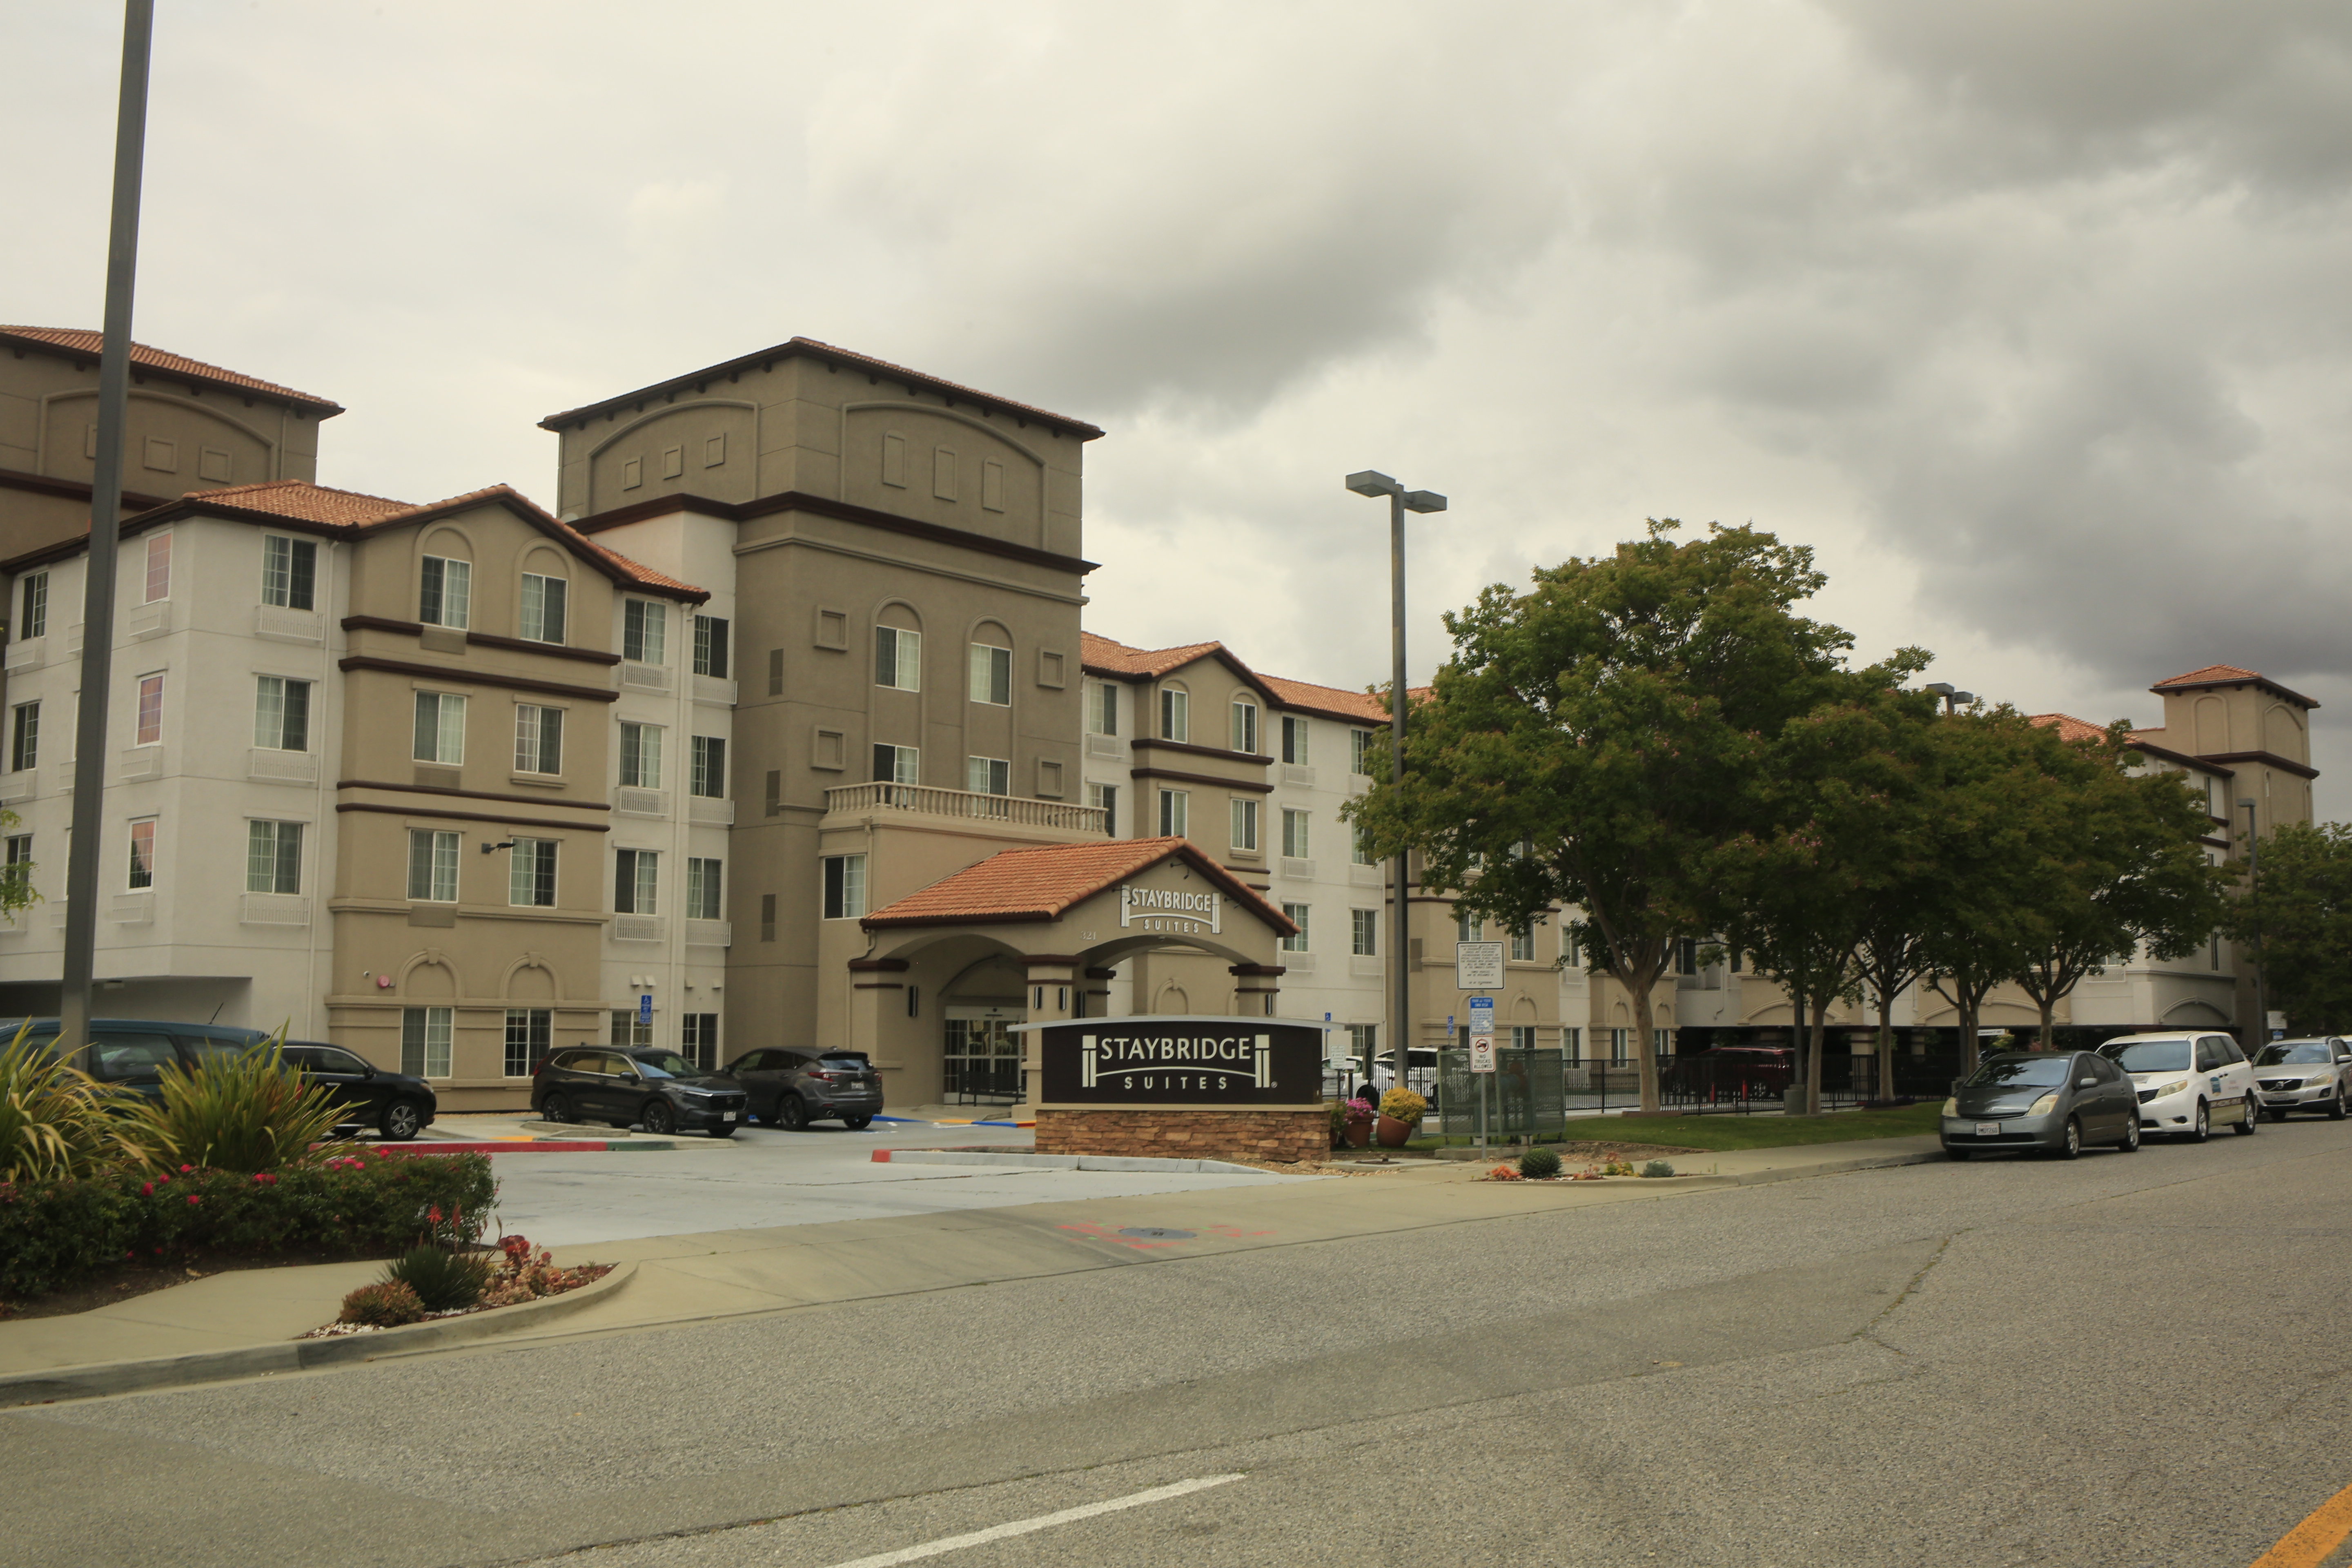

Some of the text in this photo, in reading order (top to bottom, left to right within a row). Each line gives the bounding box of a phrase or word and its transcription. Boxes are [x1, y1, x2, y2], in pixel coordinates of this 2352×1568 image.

[1131, 887, 1211, 912] STAYBRIDGE
[1144, 919, 1199, 933] SUITES
[1080, 931, 1096, 940] 321
[1100, 1037, 1251, 1060] STAYBRIDGE
[1124, 1076, 1227, 1089] SUITES
